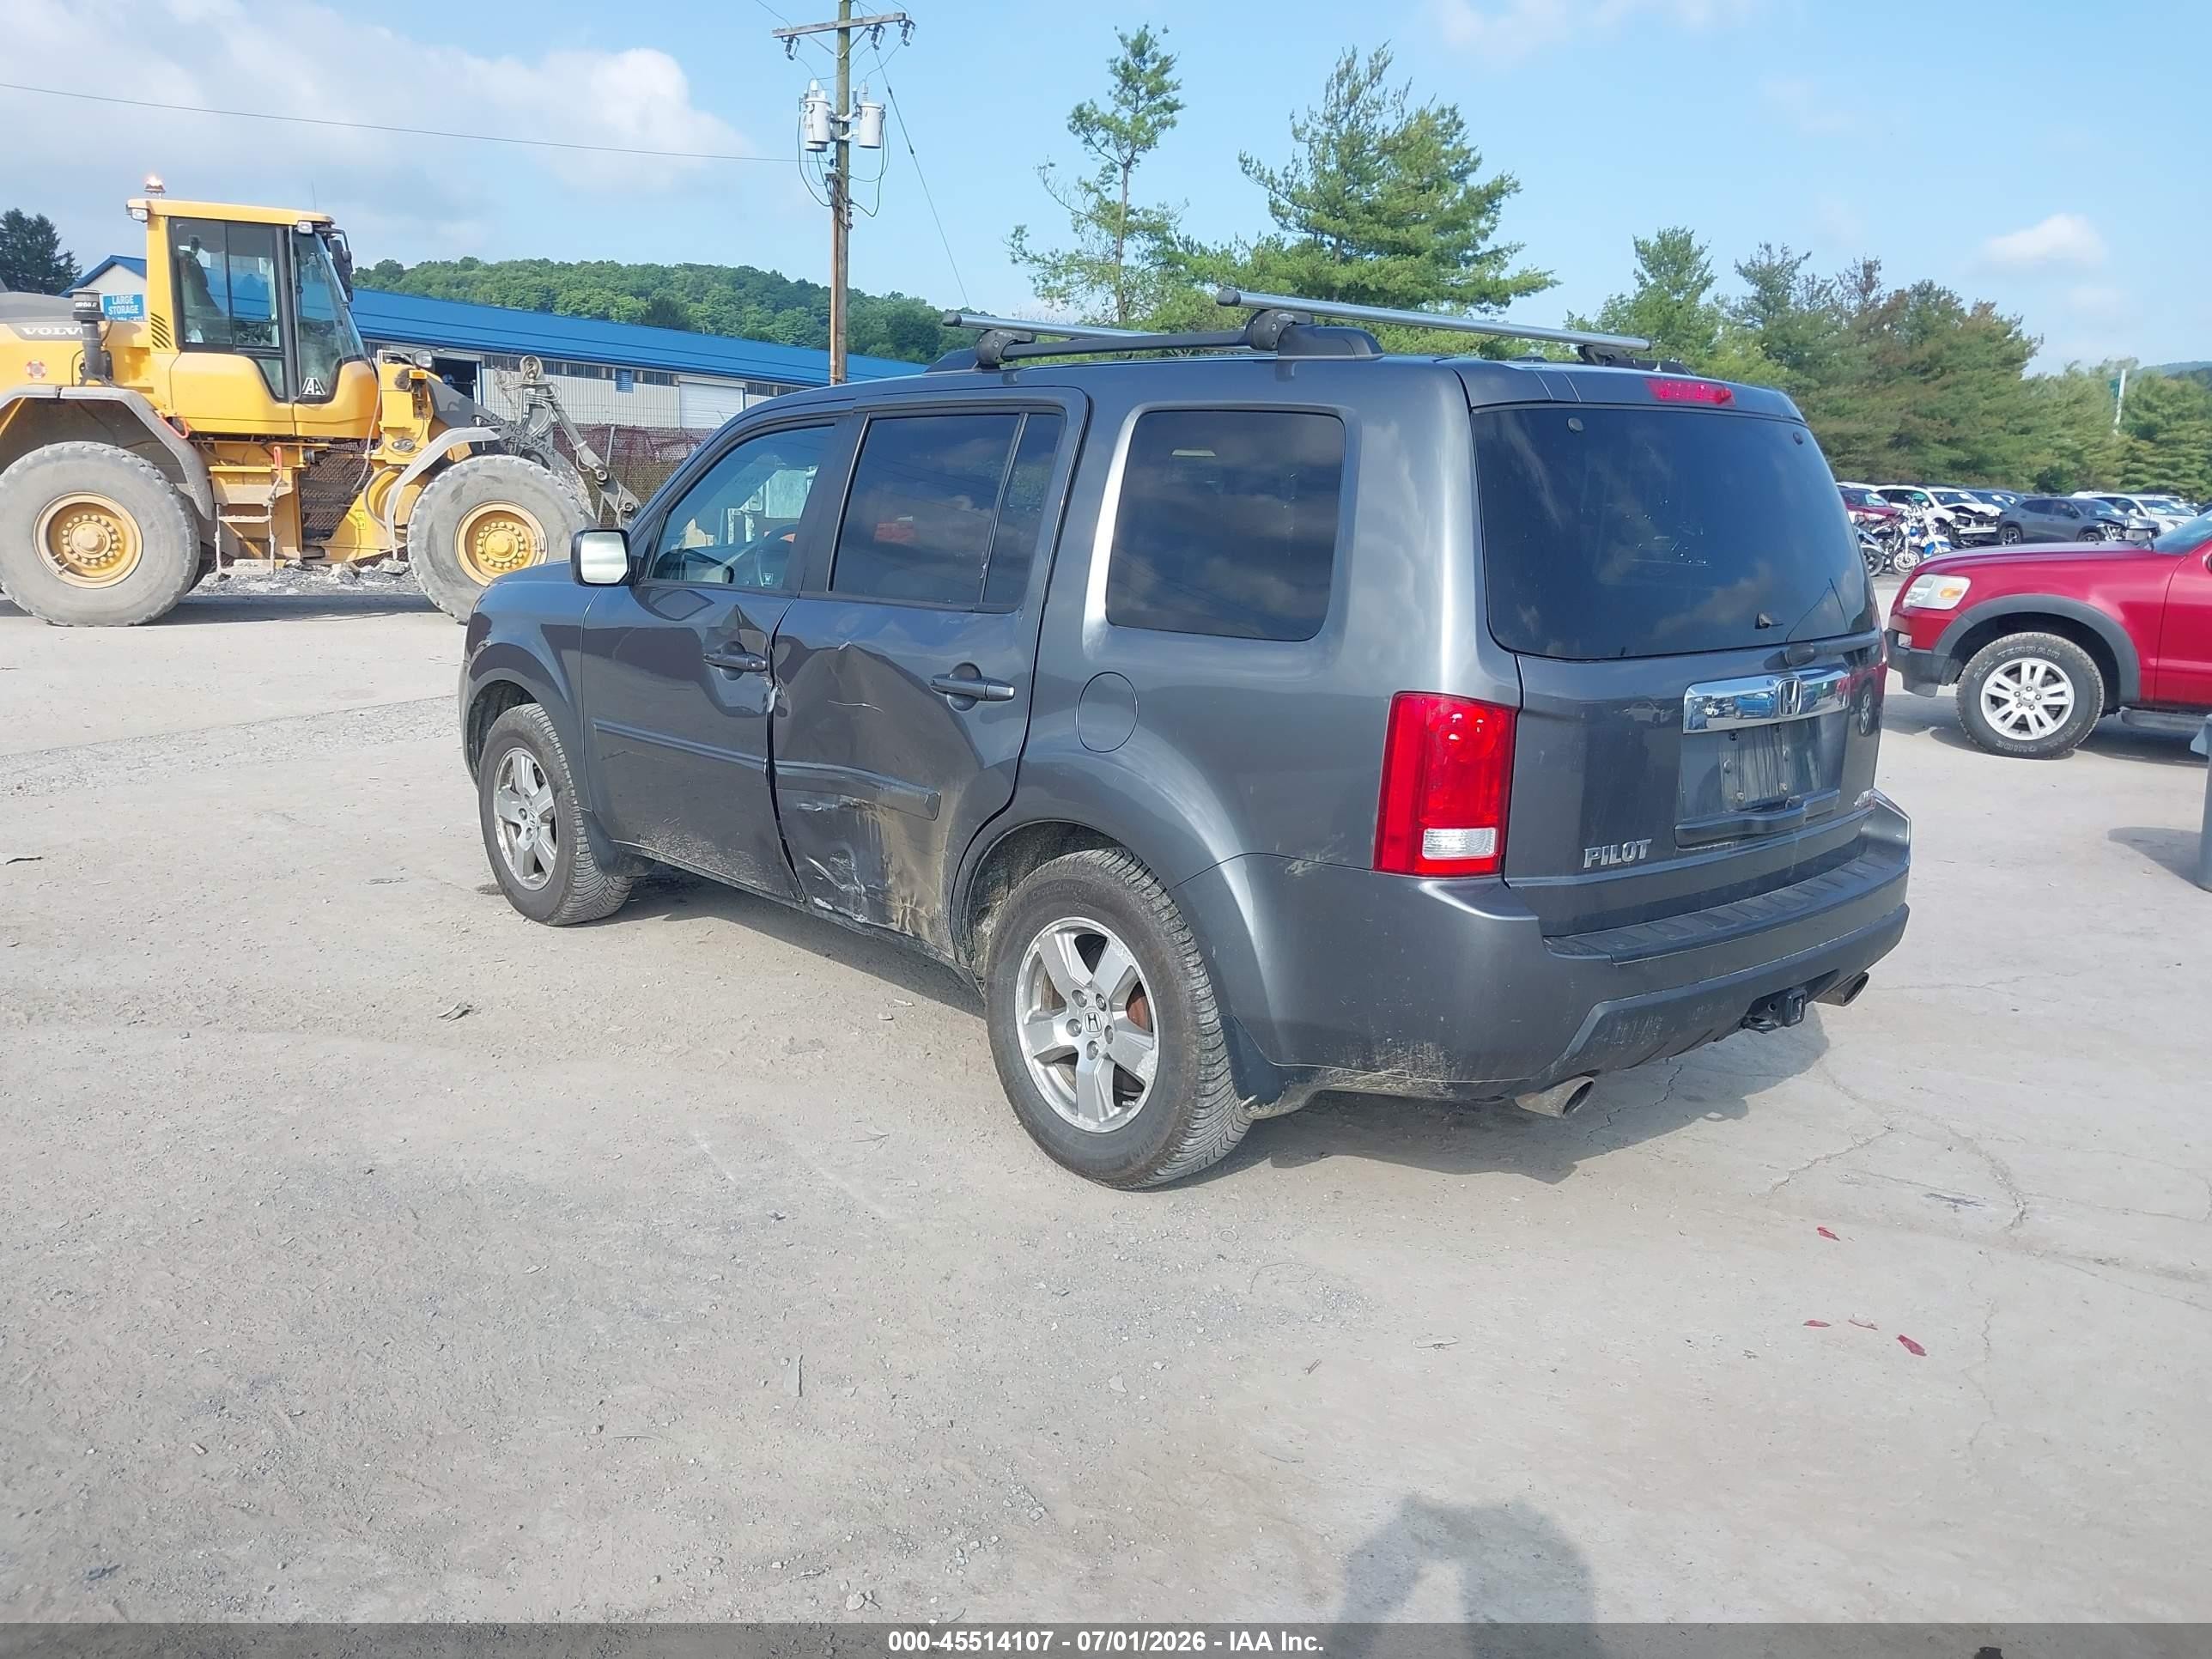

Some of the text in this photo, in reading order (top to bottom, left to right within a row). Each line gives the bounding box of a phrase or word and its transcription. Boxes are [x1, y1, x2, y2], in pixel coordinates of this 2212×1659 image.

[112, 295, 134, 305] LARGE
[108, 304, 139, 315] STORAGE
[20, 326, 83, 336] VOLV
[489, 413, 557, 458] DO NOT WALK
[1583, 838, 1653, 869] PILOT
